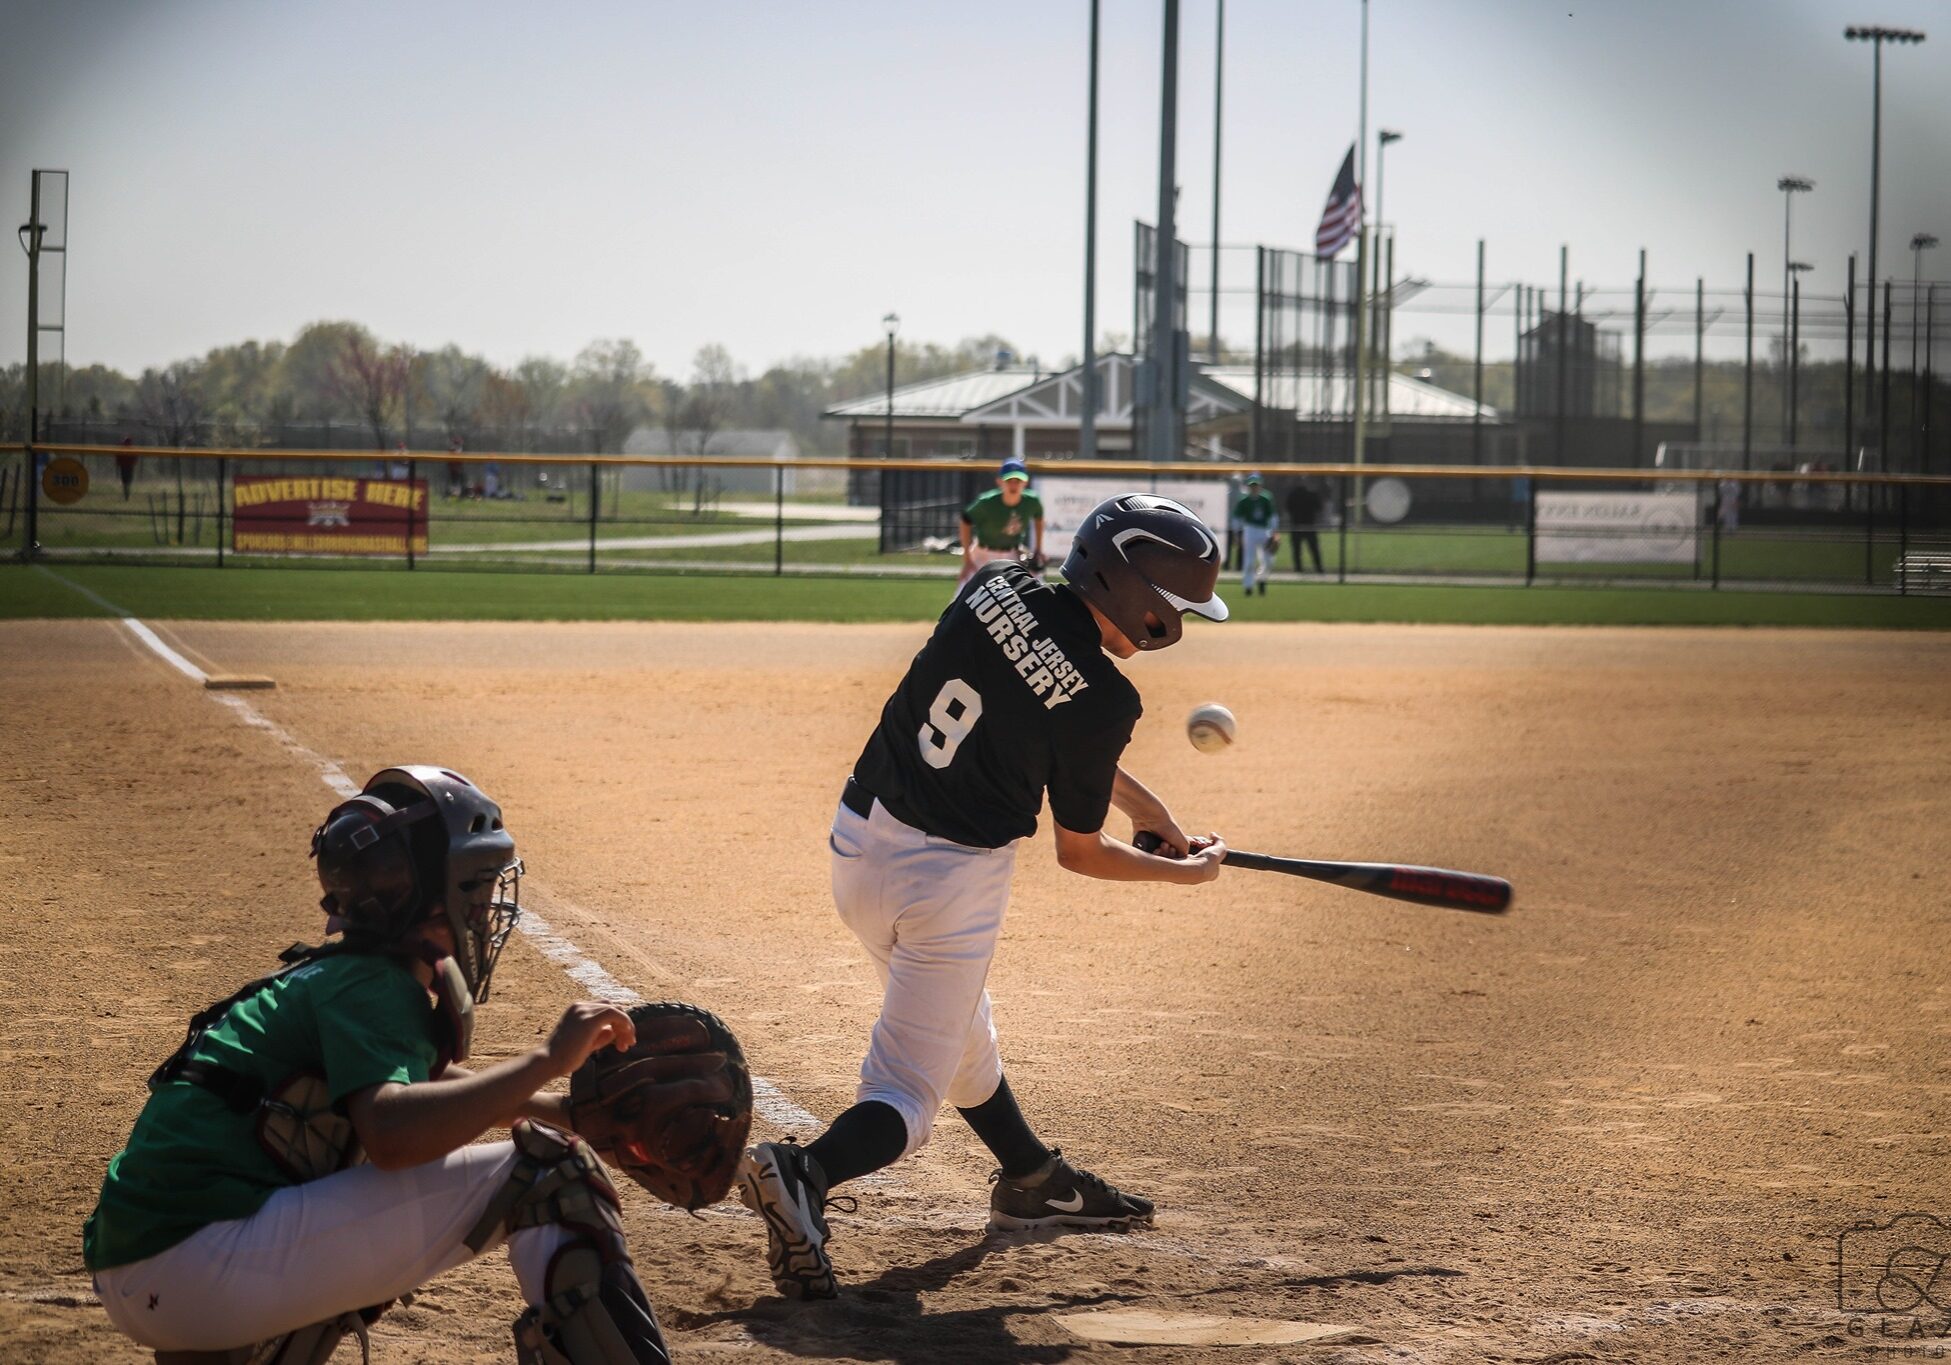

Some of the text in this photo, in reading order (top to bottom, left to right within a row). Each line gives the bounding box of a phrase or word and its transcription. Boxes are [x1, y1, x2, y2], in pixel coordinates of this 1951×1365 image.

[53, 474, 79, 487] 300
[235, 478, 358, 507] ADVERTISE
[365, 481, 425, 511] HERE
[965, 585, 1072, 710] NURSERY
[985, 575, 1089, 695] CENTRAL JERSEY
[917, 678, 983, 769] 9
